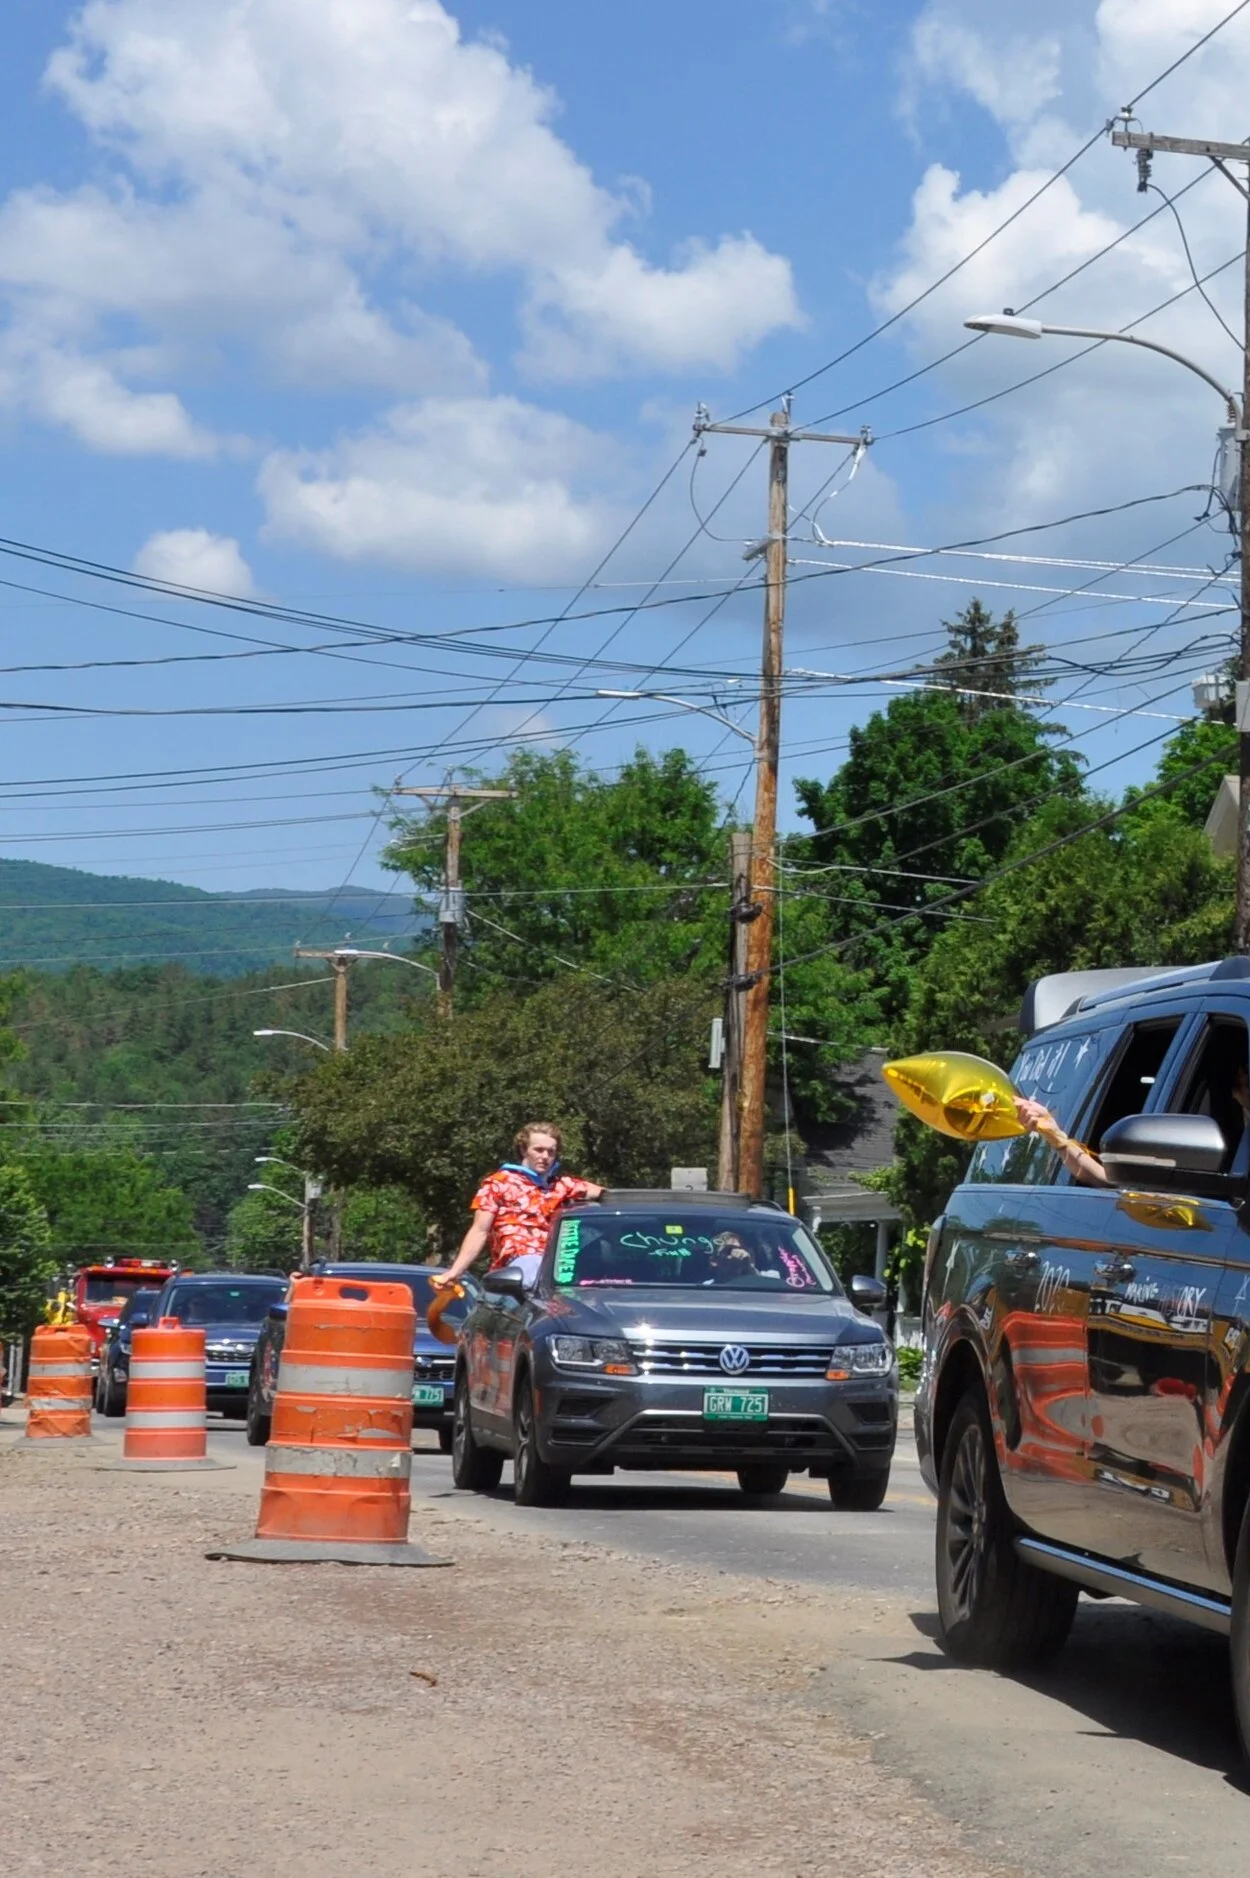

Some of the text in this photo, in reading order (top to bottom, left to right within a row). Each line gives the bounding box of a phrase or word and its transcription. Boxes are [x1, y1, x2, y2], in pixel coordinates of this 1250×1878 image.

[1034, 1260, 1071, 1315] 2020
[709, 1396, 762, 1412] GRW 725
